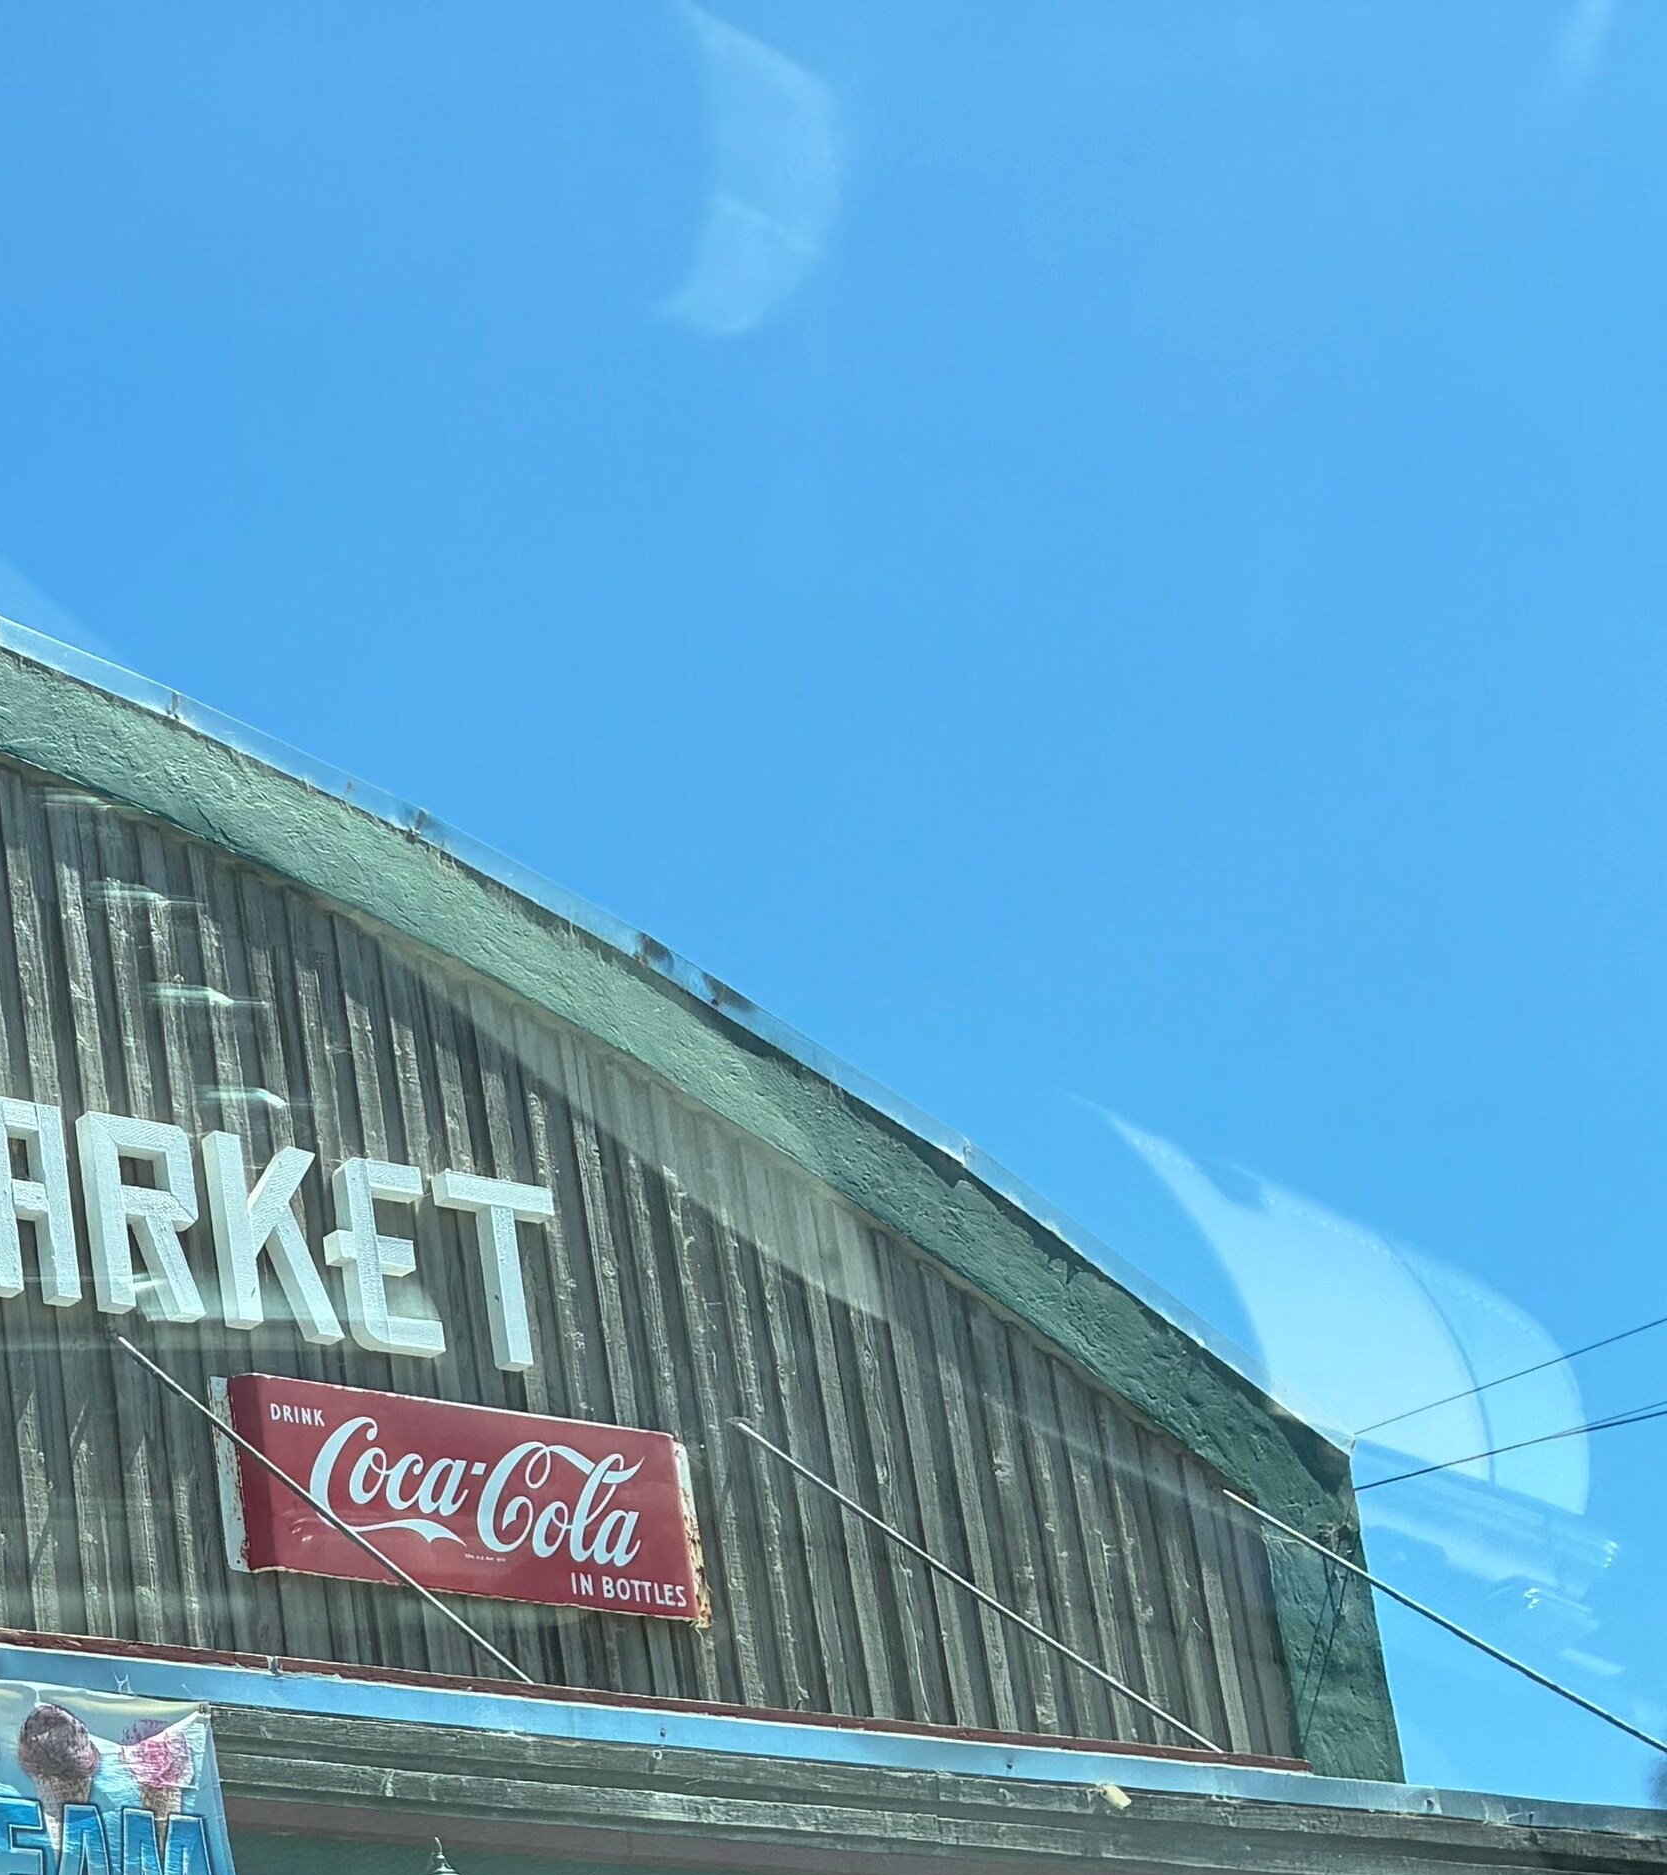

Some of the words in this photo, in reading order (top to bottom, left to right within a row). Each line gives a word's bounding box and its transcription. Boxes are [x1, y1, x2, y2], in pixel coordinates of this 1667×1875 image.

[269, 1402, 326, 1428] DRINK
[308, 1415, 646, 1567] Coca-Cola
[570, 1572, 595, 1598] IN
[602, 1577, 688, 1608] BOTTLES
